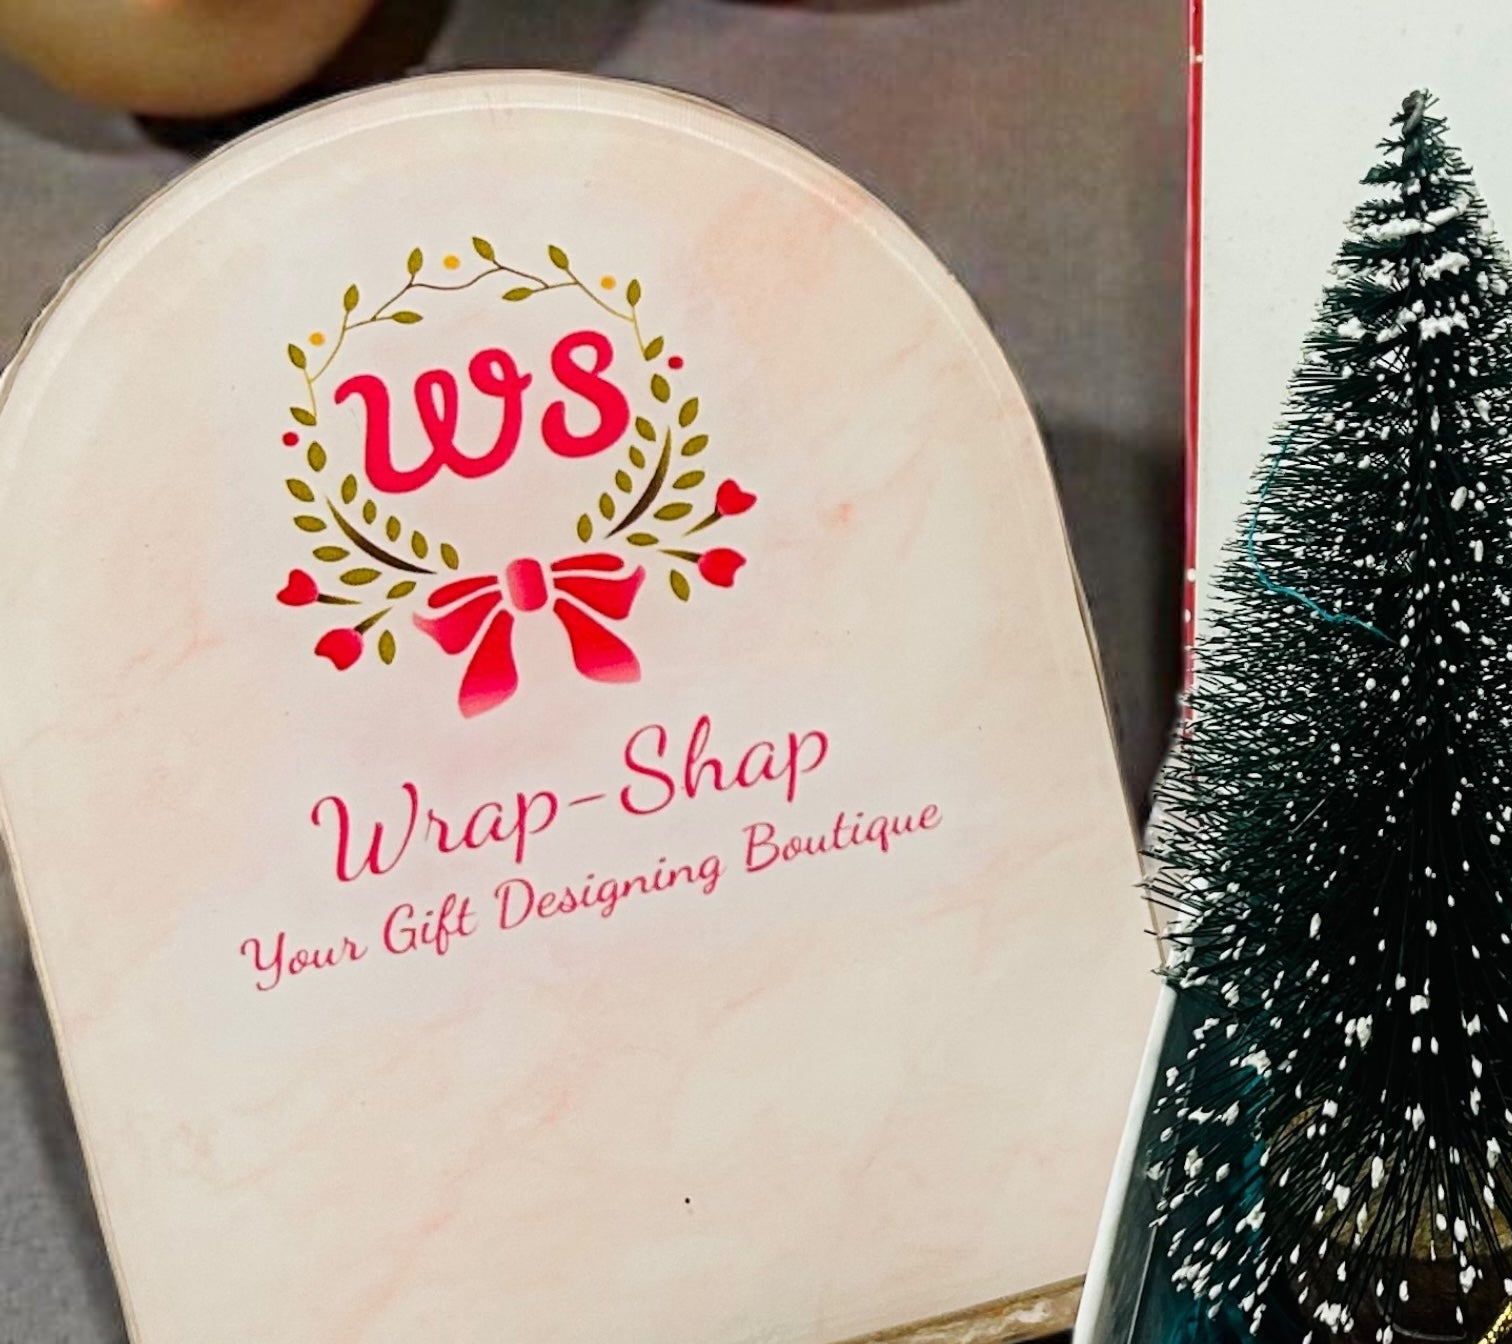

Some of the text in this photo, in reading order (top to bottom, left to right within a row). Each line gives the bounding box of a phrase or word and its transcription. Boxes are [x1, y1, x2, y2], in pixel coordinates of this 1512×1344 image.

[311, 713, 829, 883] Wrap-Shap
[240, 803, 942, 992] Your Gift Designing Boutique
